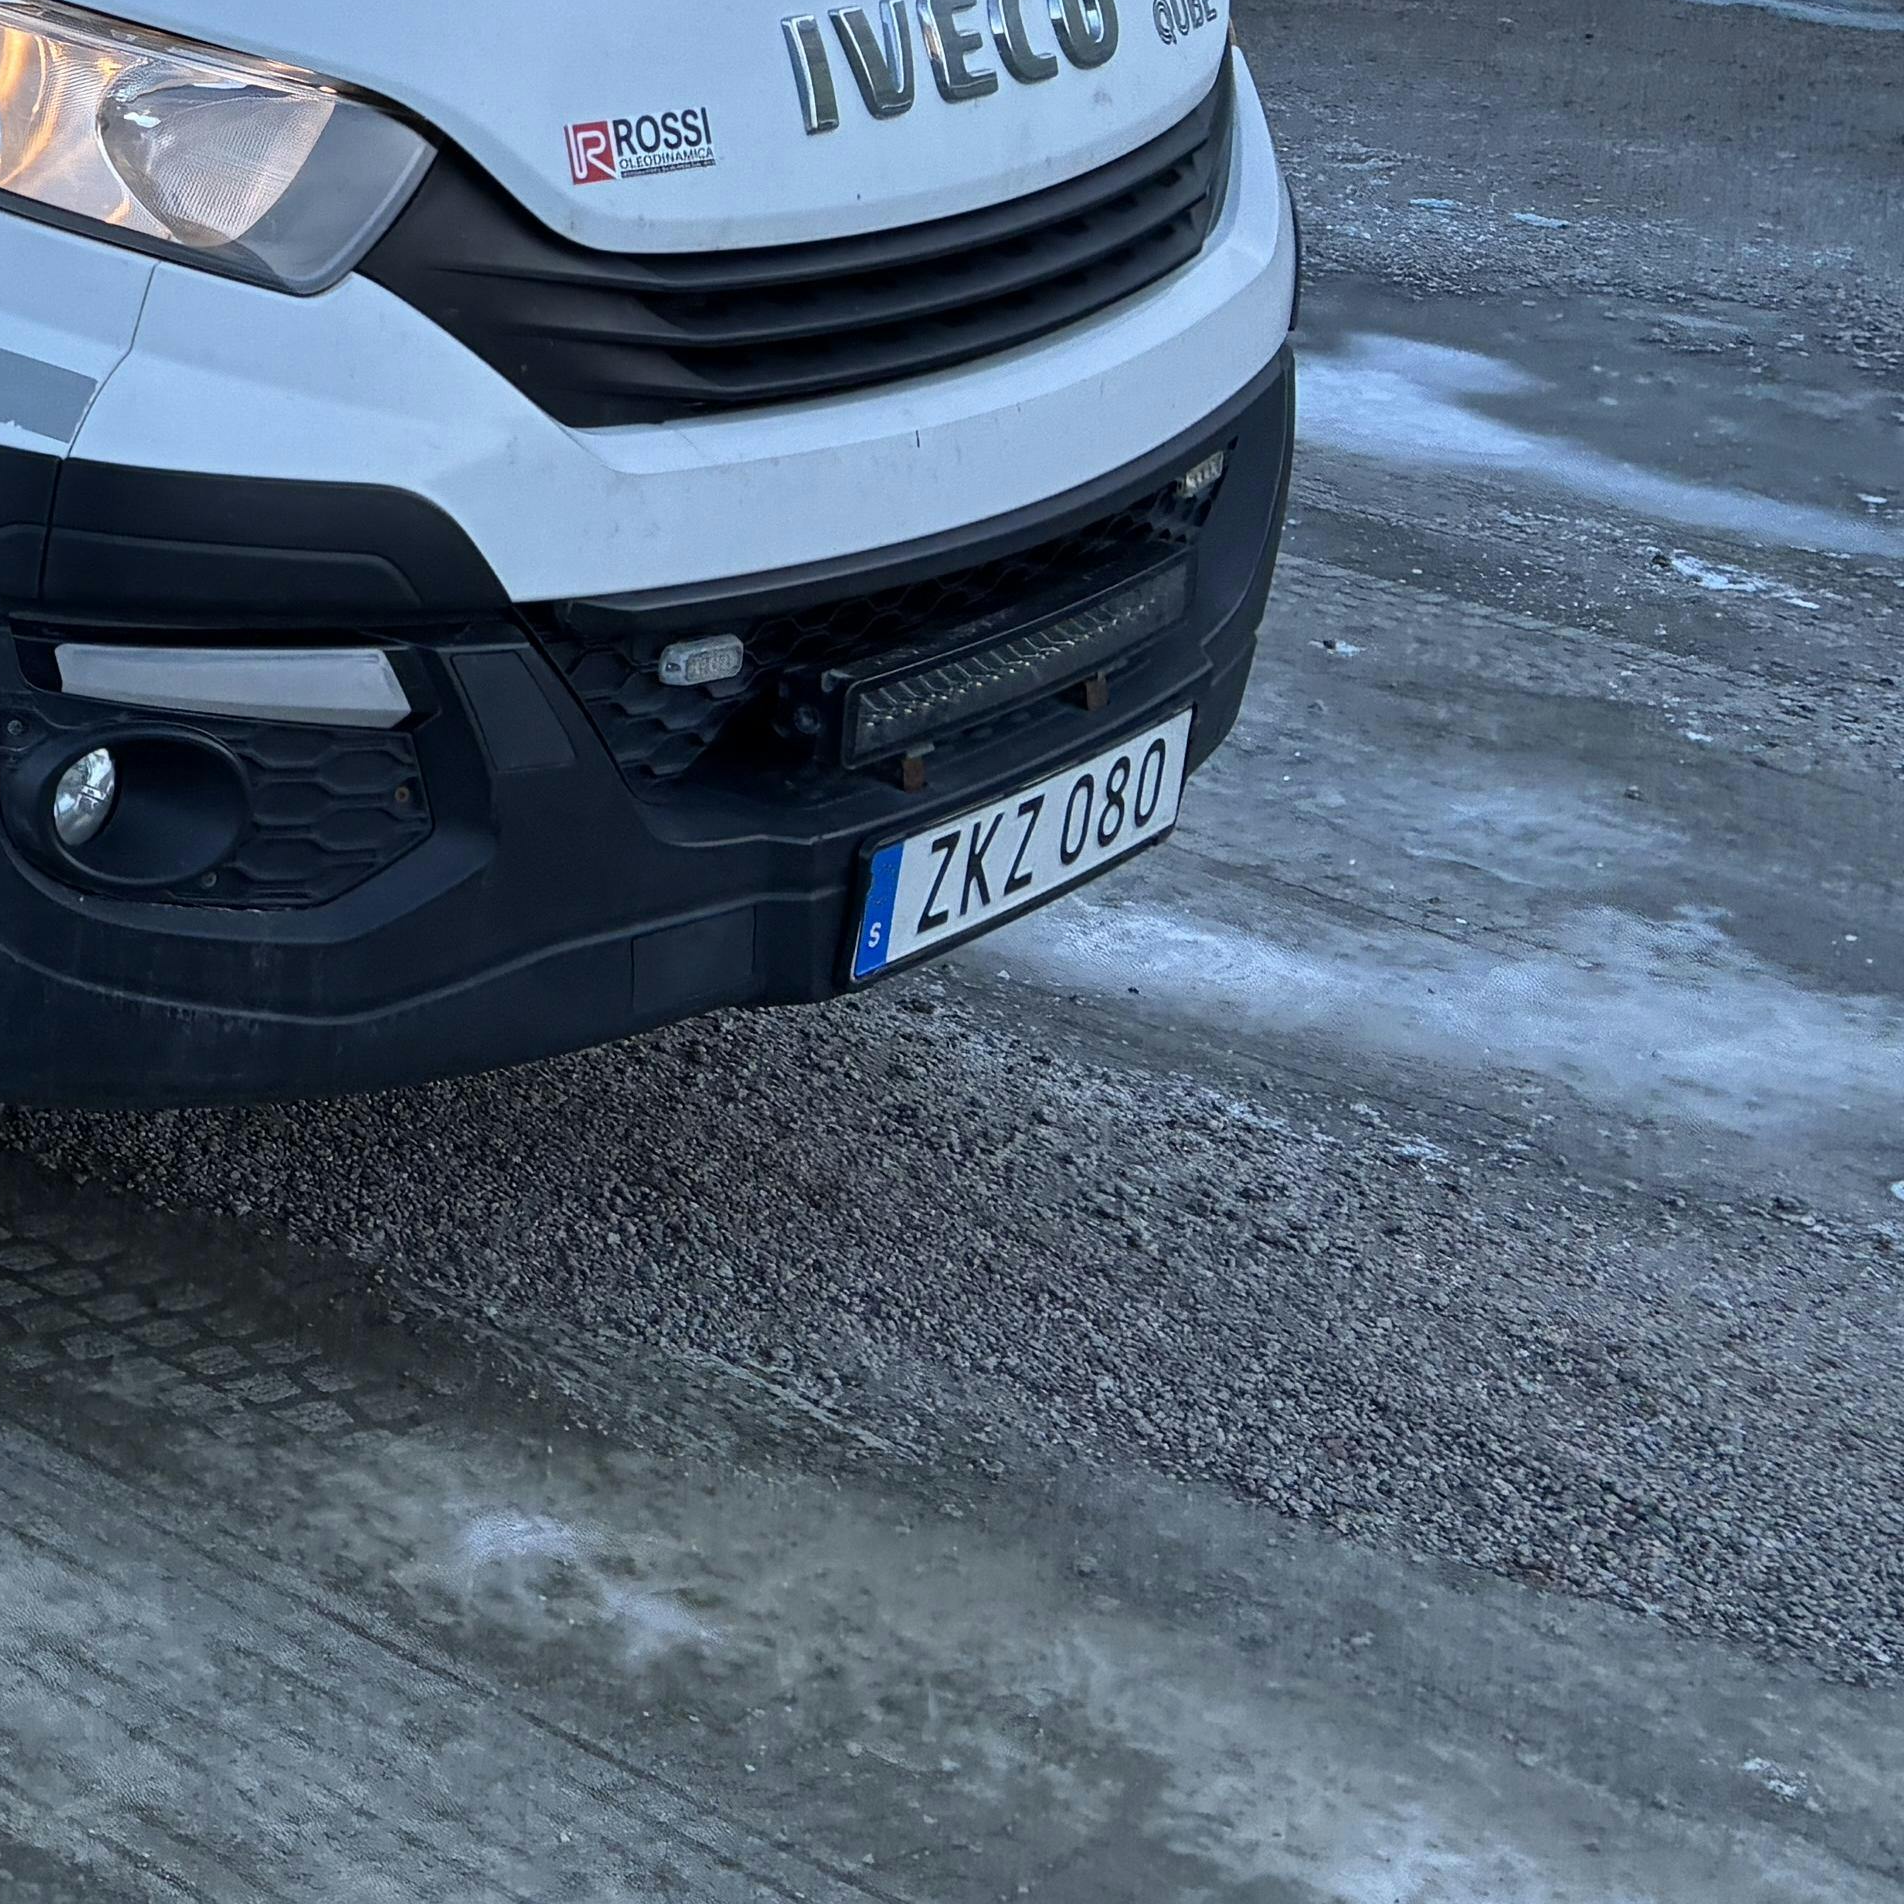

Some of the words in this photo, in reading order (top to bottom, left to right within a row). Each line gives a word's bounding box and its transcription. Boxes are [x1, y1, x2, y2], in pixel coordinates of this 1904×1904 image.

[612, 106, 713, 157] ROSSI
[619, 147, 715, 171] OLEODINAMICA
[868, 922, 883, 949] S
[915, 793, 1046, 936] ZKZ
[1059, 737, 1168, 867] 080
